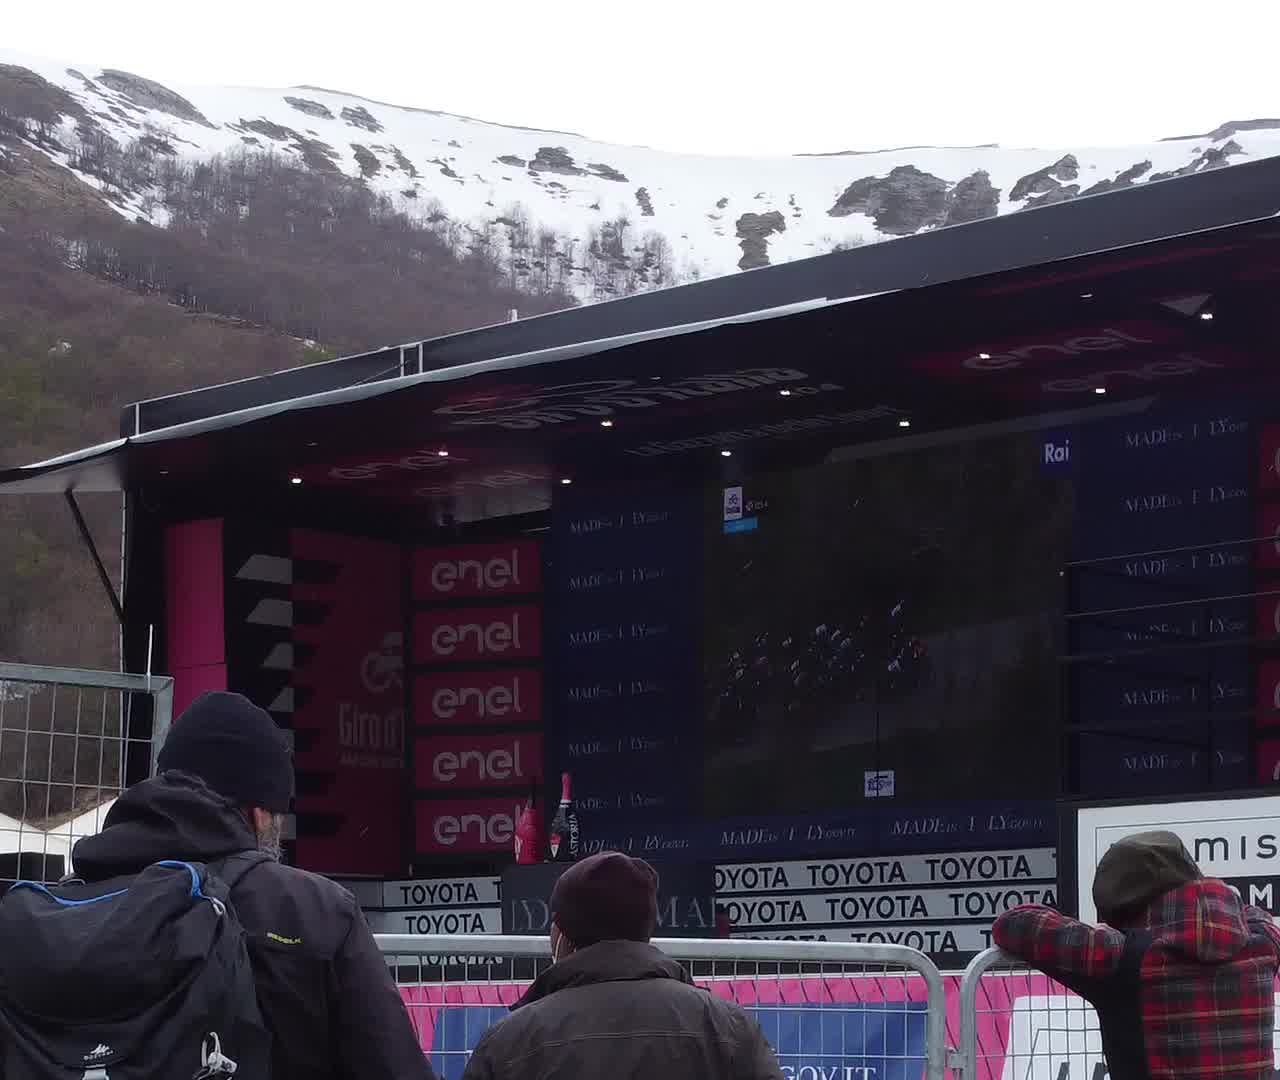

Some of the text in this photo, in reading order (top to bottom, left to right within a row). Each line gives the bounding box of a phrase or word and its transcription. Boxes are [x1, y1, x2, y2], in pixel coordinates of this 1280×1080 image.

[1044, 438, 1070, 464] Rai
[431, 548, 520, 592] enel
[431, 612, 520, 656] enel
[431, 676, 522, 719] enel
[432, 740, 523, 782] enel
[714, 855, 1032, 889] OYOTA TOYOTA TOYOTA
[400, 882, 478, 904] TOYOTA
[729, 901, 807, 924] OYOTA
[826, 895, 928, 920] TOYOTA
[404, 913, 486, 934] TOYOTA
